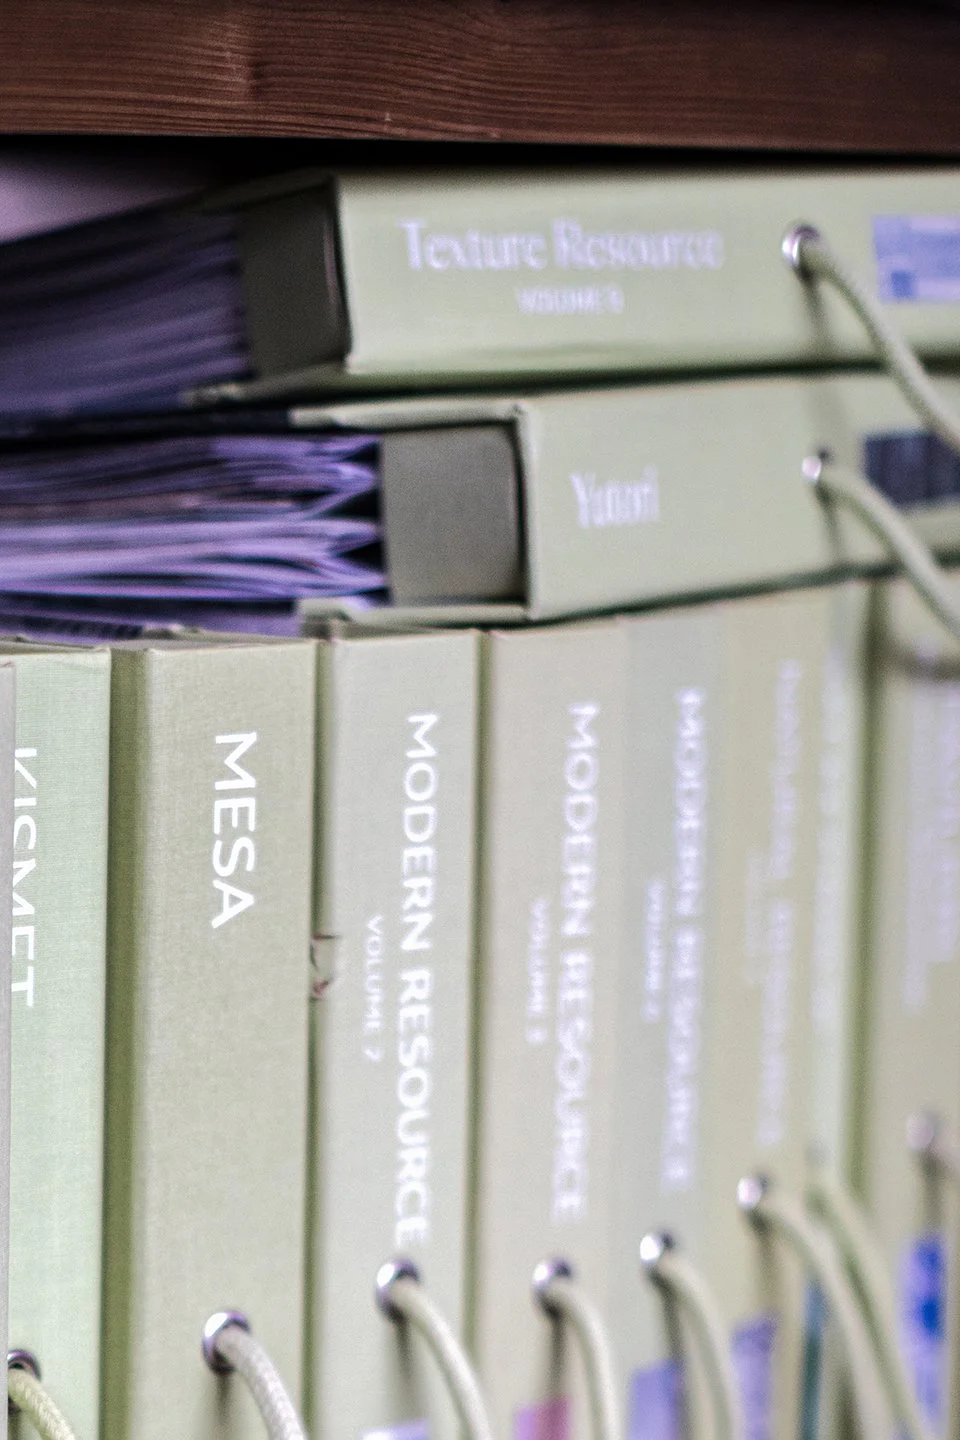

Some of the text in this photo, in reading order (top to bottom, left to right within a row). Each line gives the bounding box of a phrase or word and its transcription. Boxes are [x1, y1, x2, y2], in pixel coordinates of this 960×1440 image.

[399, 218, 725, 270] Texture Resource
[211, 731, 259, 929] MESA
[365, 915, 385, 1034] VOLUME
[394, 713, 438, 1248] MODERN RESOURCE
[553, 703, 598, 1222] MODERN RESOURCE
